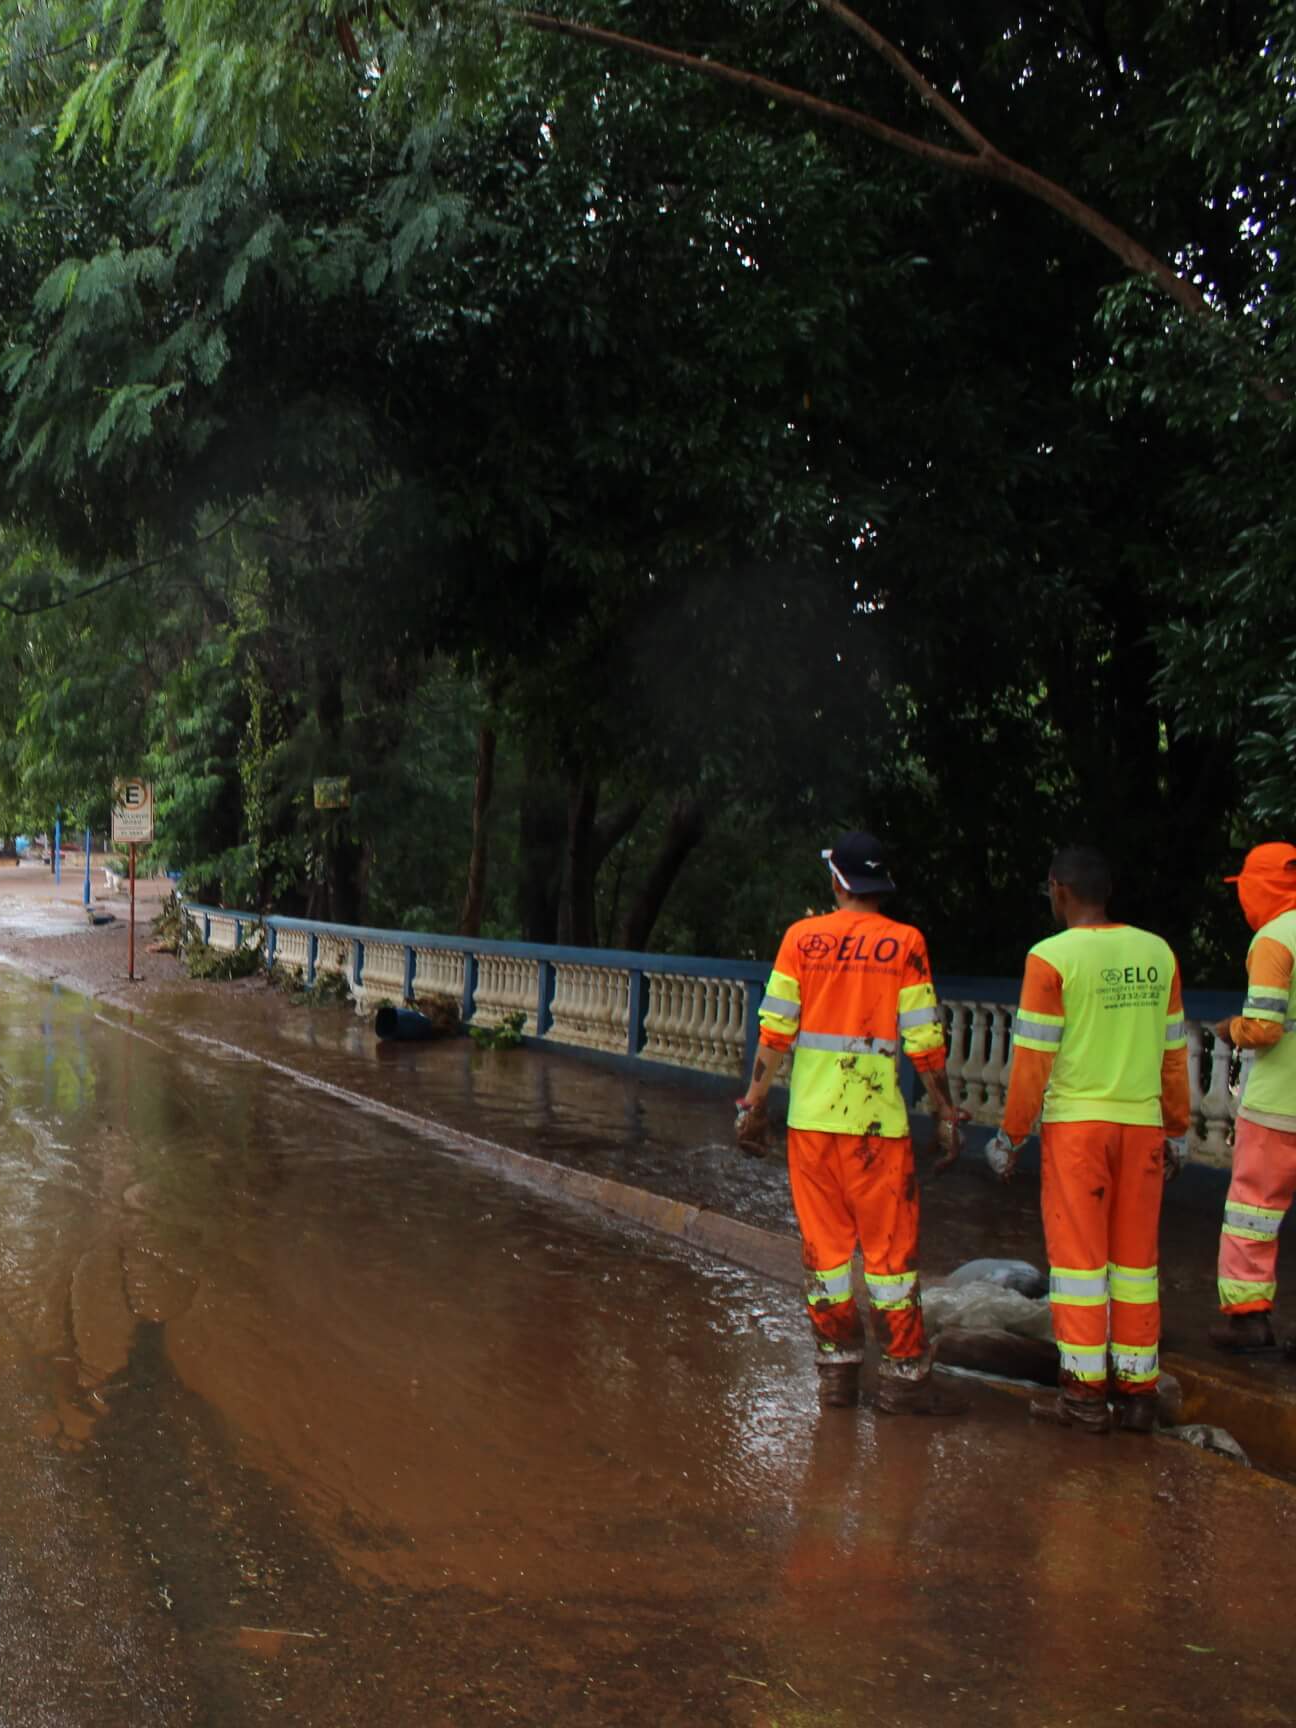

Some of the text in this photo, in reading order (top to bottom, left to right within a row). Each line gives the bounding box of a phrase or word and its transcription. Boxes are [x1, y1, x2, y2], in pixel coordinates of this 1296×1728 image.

[126, 785, 139, 804] E
[836, 935, 900, 962] ELO
[1124, 966, 1158, 983] ELO
